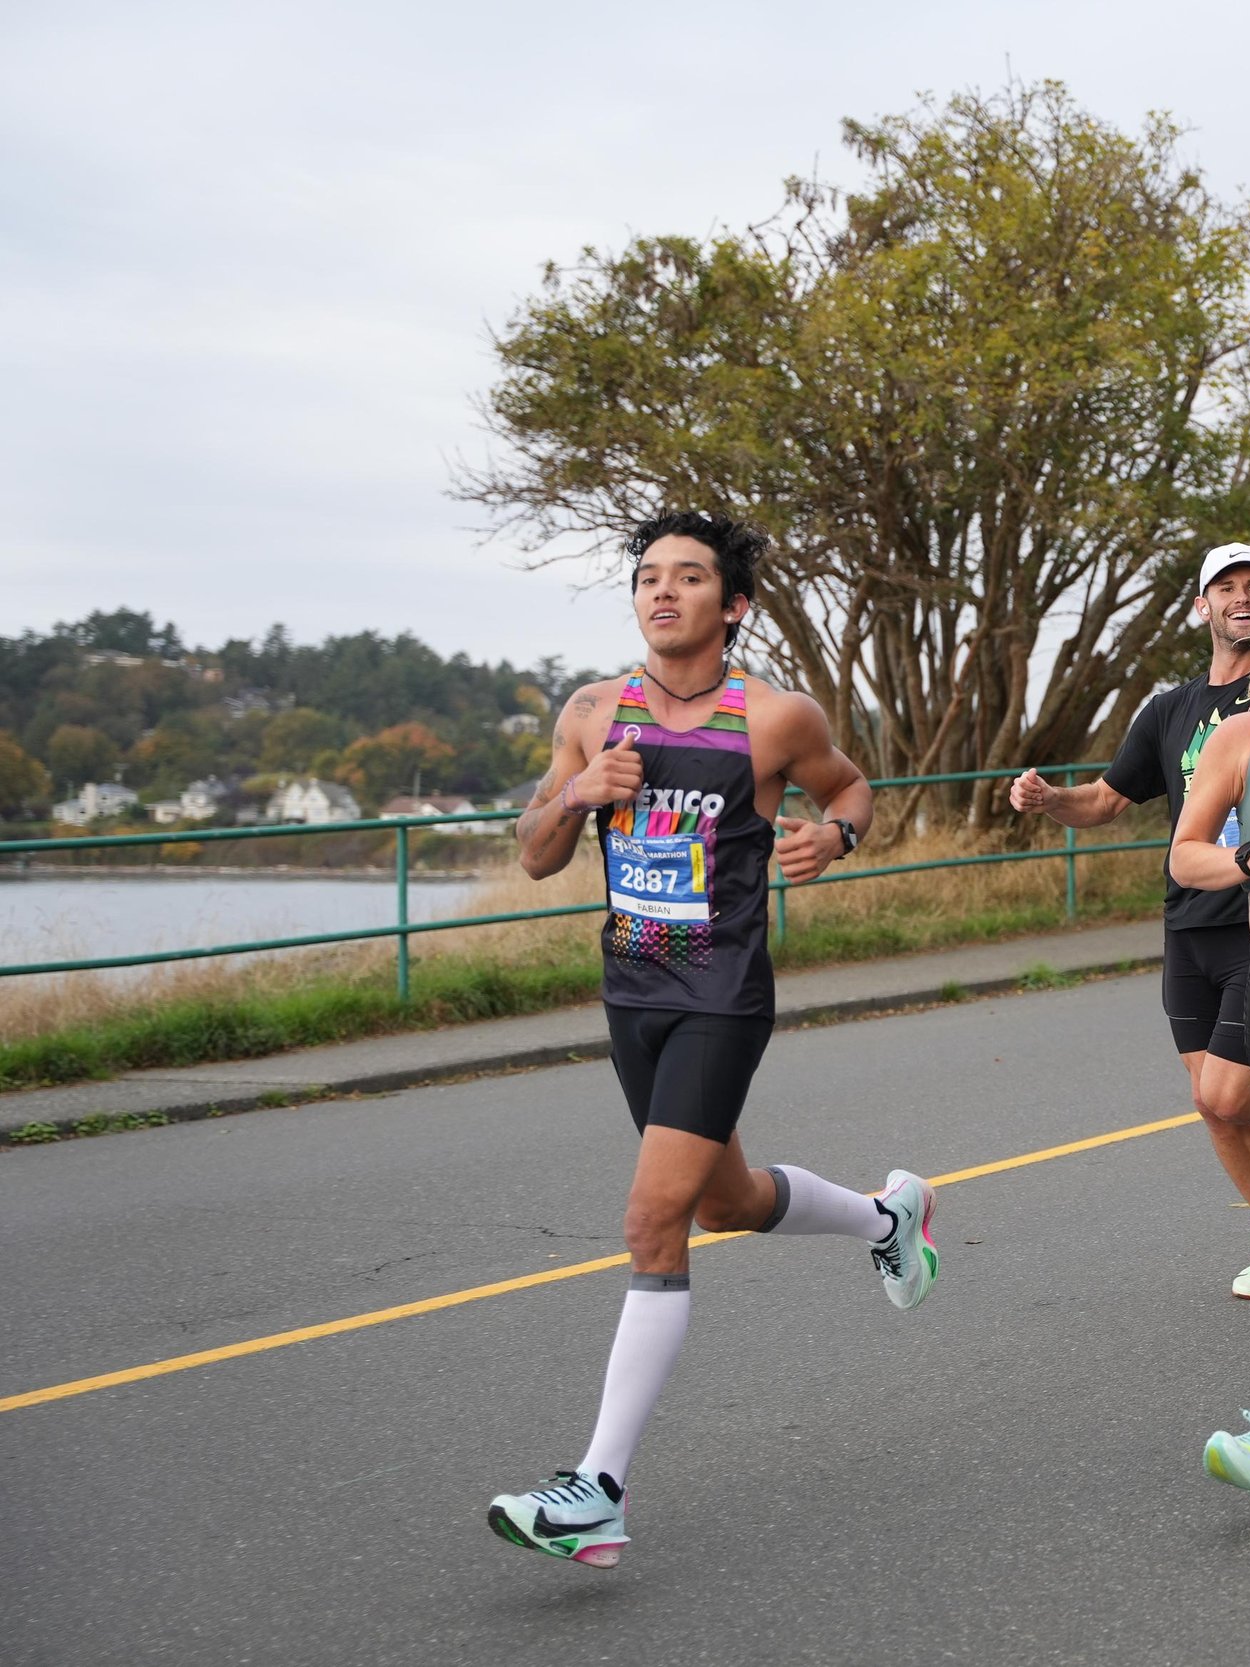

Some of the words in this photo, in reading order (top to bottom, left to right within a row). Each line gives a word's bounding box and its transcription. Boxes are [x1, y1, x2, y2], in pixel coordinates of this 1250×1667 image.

[647, 851, 687, 859] MARATHON
[620, 863, 678, 893] 2887
[637, 903, 671, 915] FABIAN
